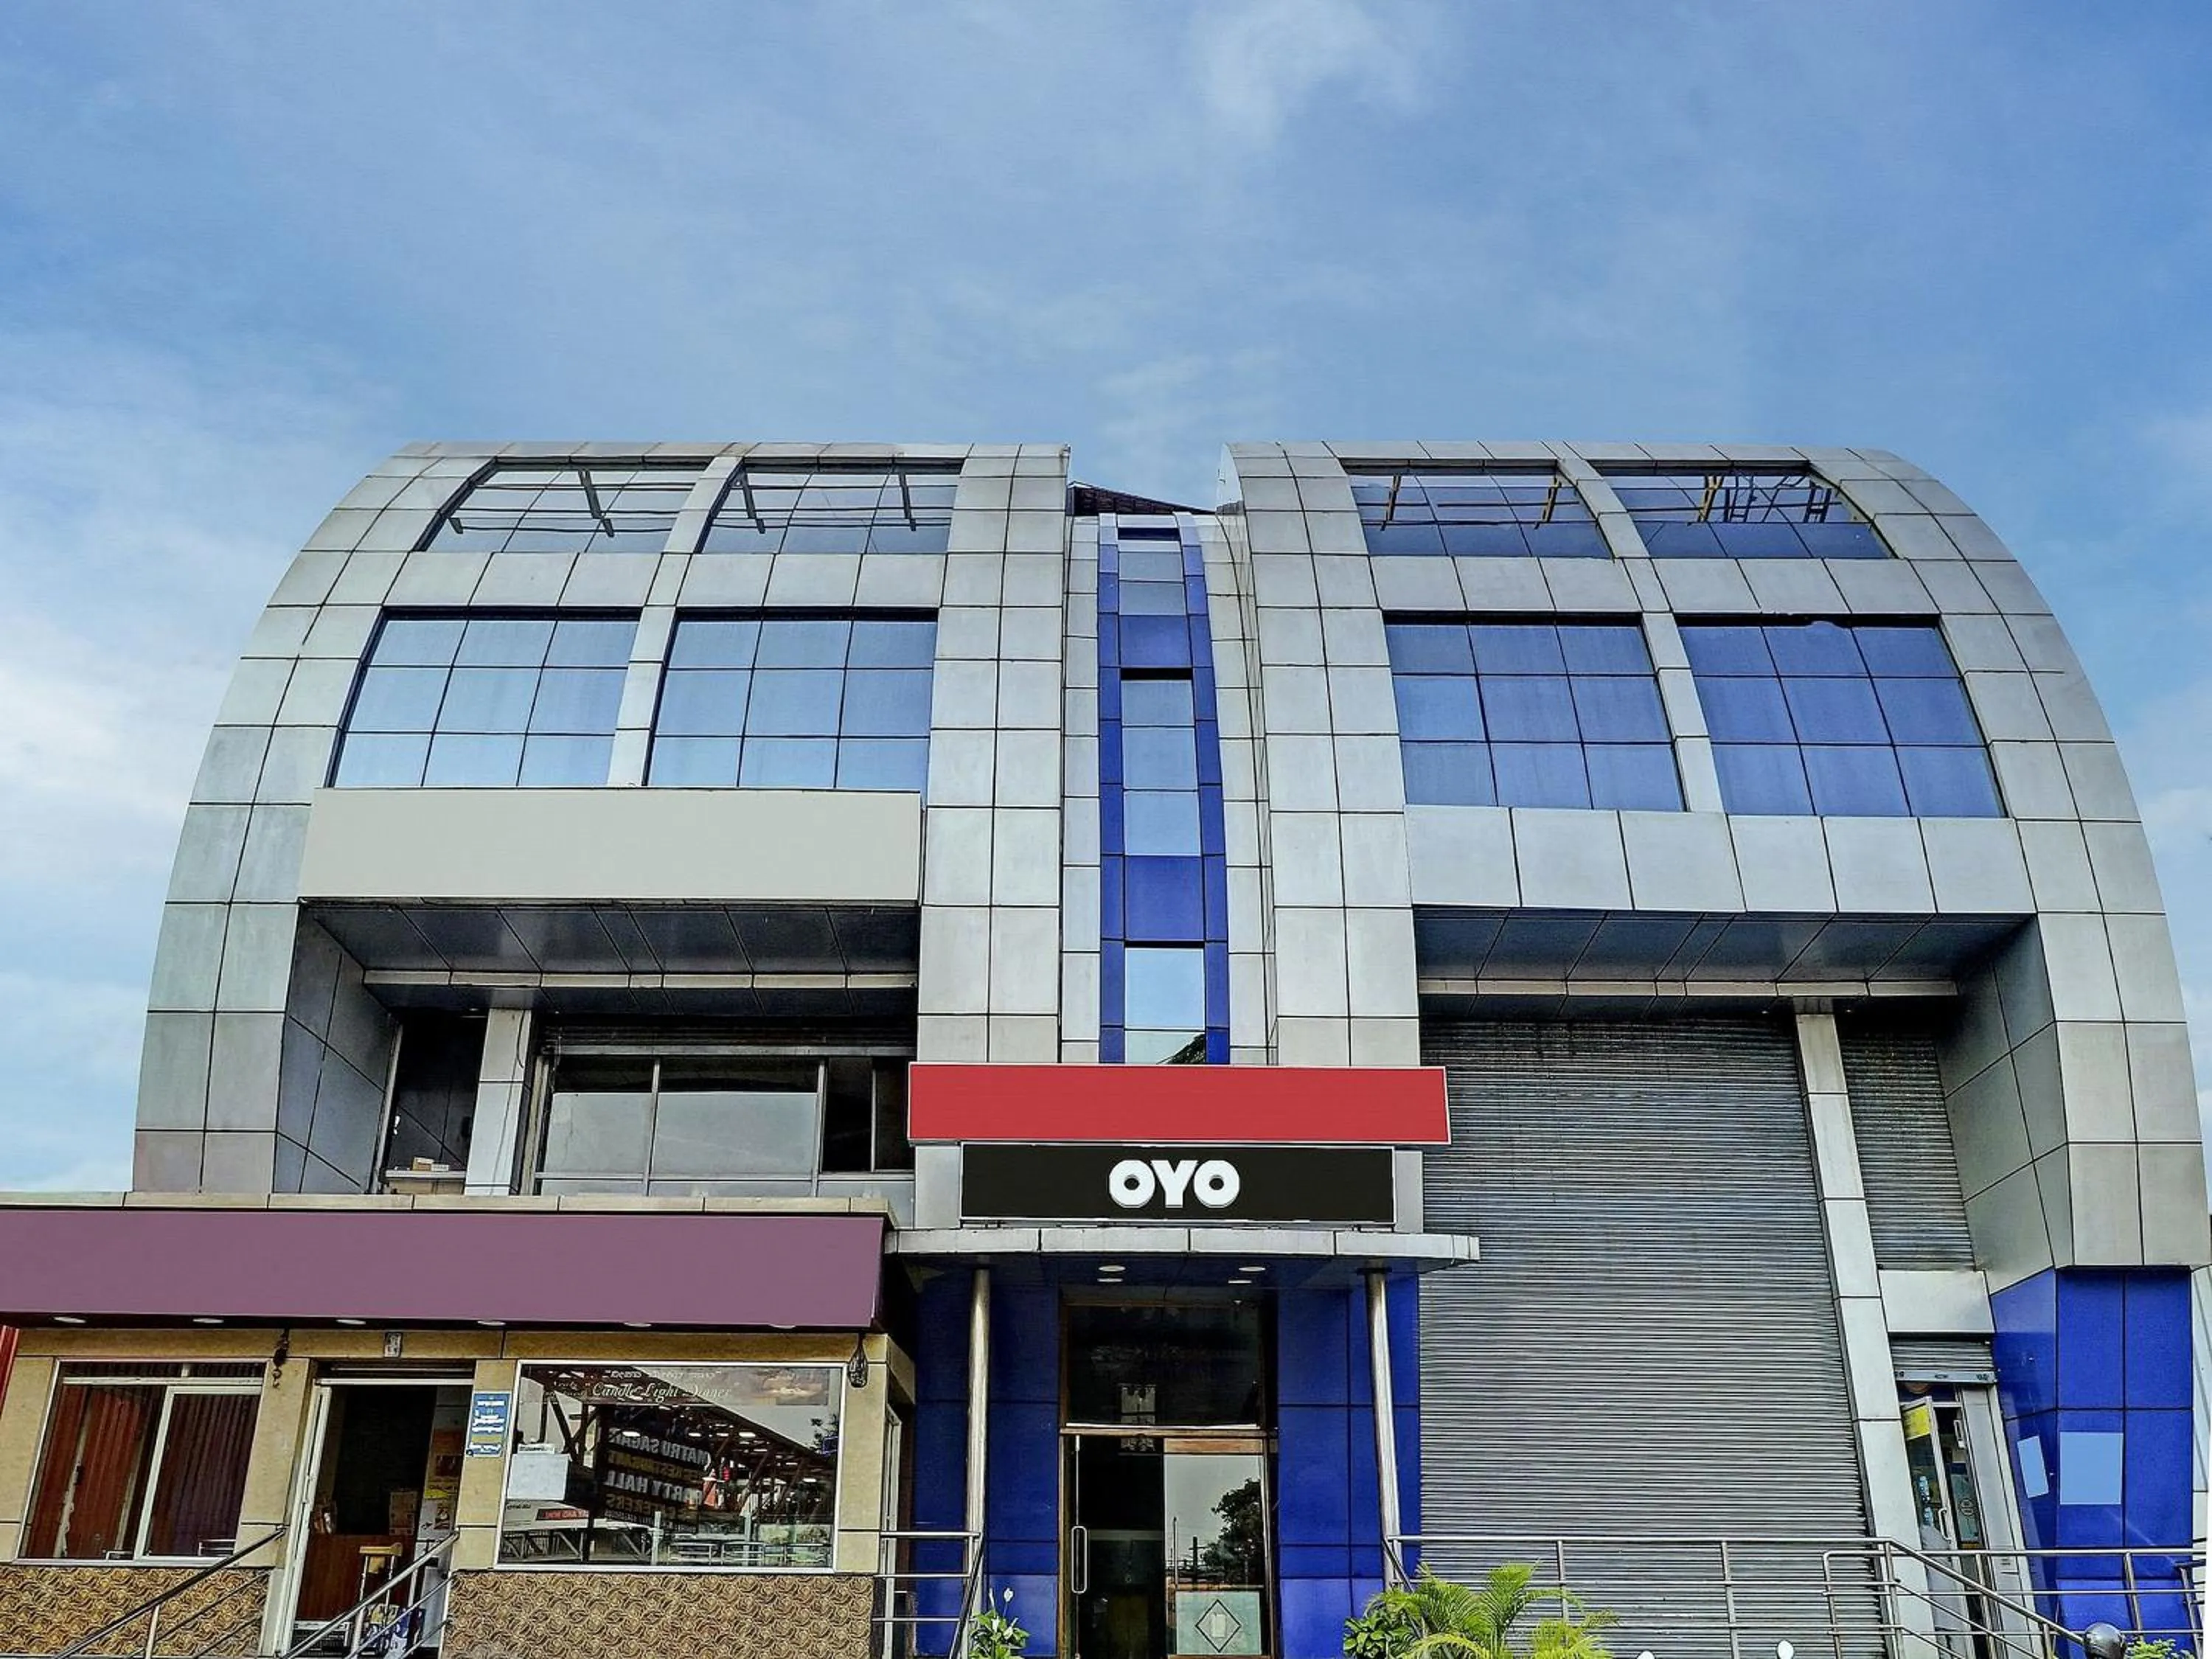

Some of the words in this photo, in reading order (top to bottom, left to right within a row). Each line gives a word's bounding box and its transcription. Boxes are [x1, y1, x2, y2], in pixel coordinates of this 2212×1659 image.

[1108, 1159, 1240, 1209] OYO
[592, 1382, 636, 1397] Candle
[641, 1382, 679, 1403] Light
